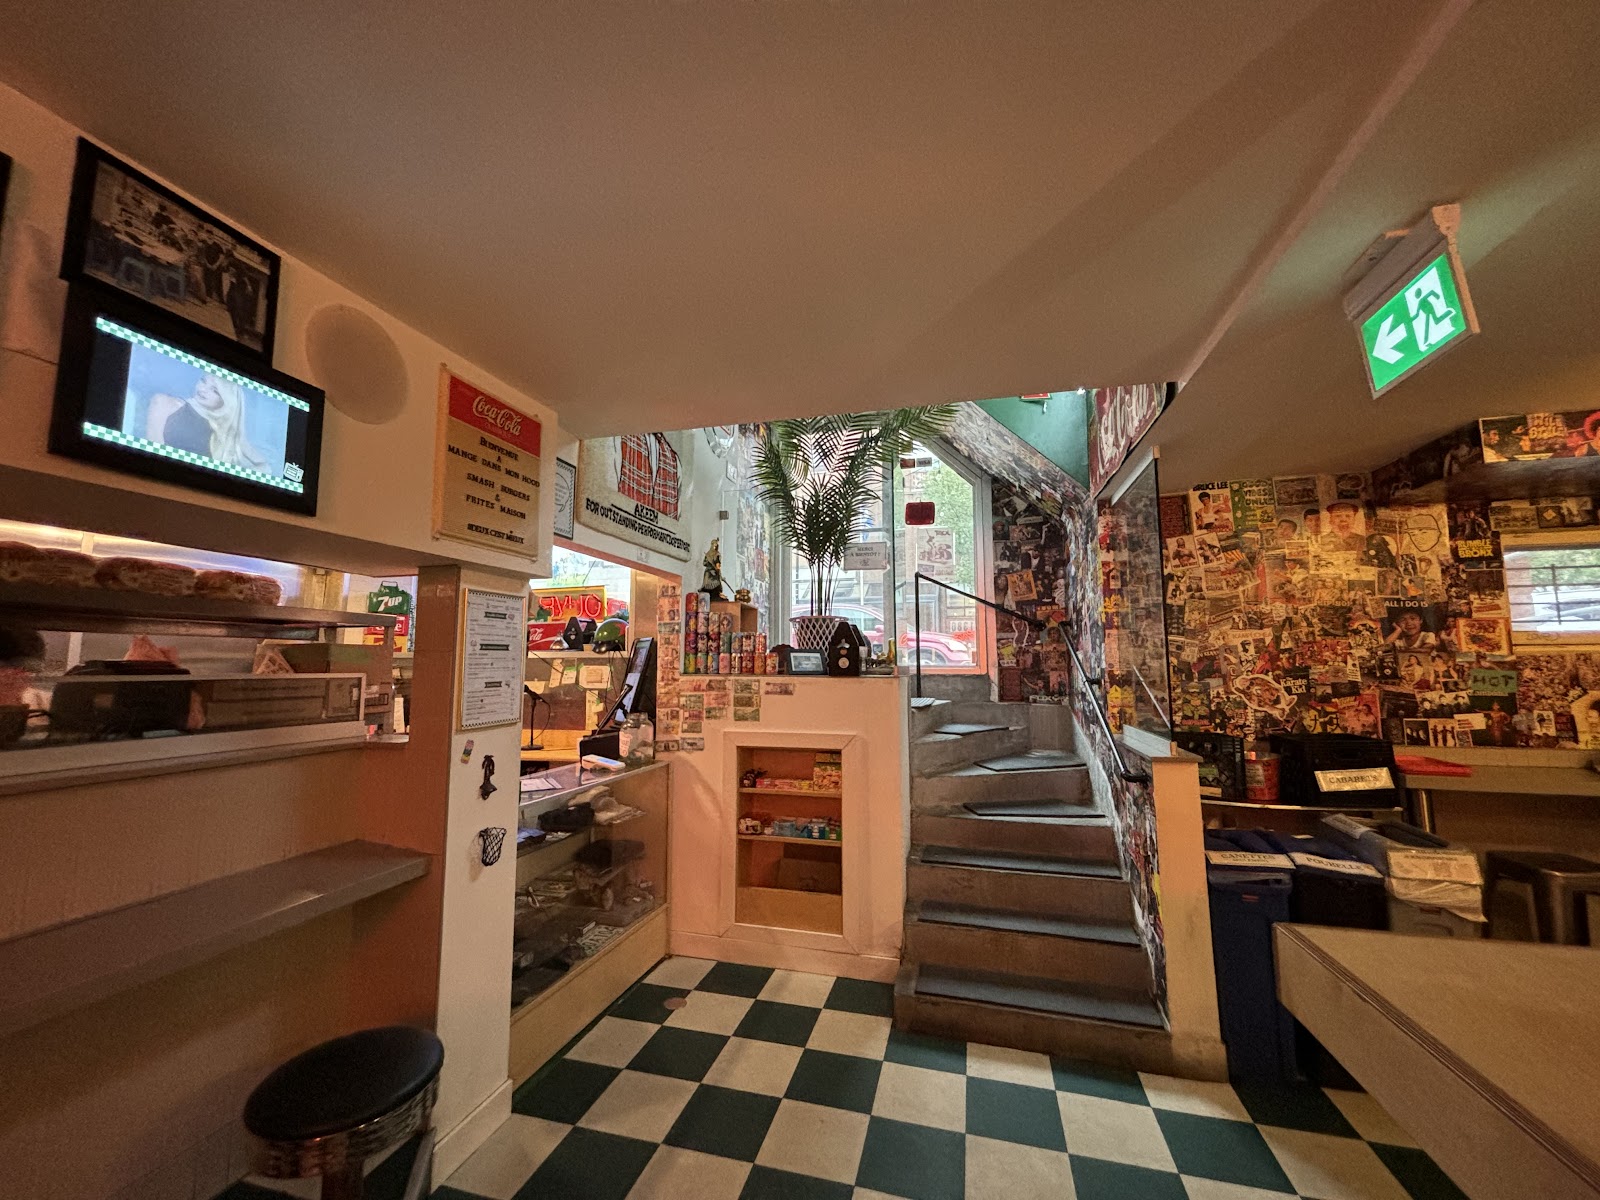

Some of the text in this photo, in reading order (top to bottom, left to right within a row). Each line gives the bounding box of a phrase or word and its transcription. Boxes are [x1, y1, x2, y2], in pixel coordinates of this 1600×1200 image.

[473, 396, 522, 436] Coca-Cola
[480, 436, 518, 461] BIENVENUE
[448, 444, 540, 488] MANGE DANS MON HOOD
[466, 472, 530, 501] SMASH BURGERS
[1193, 481, 1228, 491] BRUCE LEE
[495, 493, 500, 502] &
[465, 494, 525, 519] FRITES MAISON
[634, 502, 659, 525] AKEEM
[586, 498, 599, 515] FOR
[600, 506, 637, 532] OUTSTANDING
[1456, 539, 1491, 548] RUMBLE
[1459, 549, 1493, 558] BRONX
[378, 596, 402, 612] 7UP
[1420, 600, 1428, 608] IS
[1281, 678, 1307, 687] Karate
[1291, 685, 1306, 694] Kid
